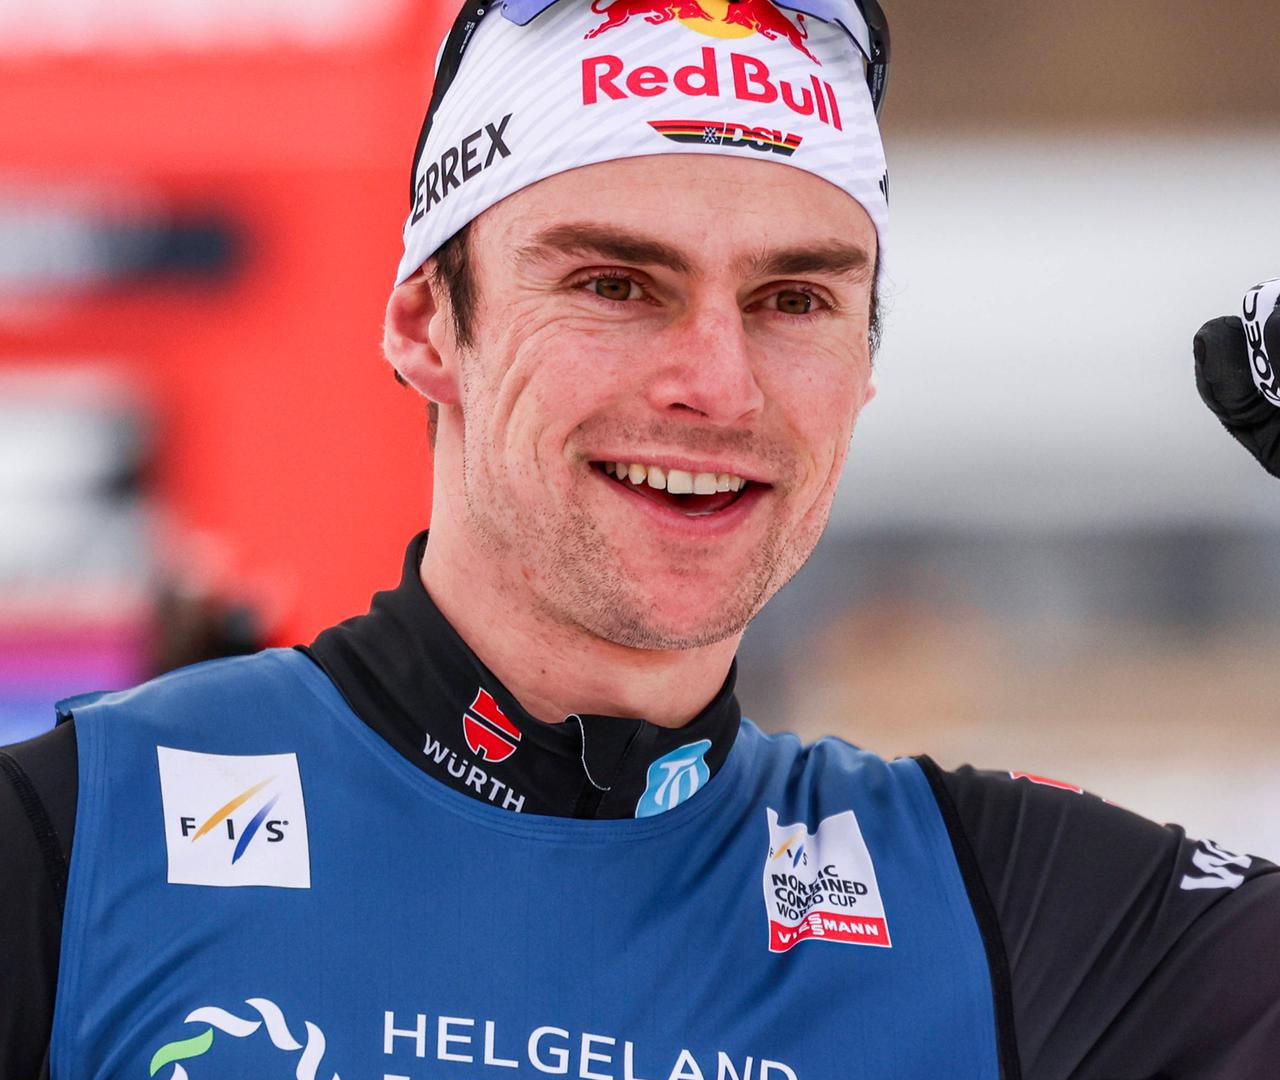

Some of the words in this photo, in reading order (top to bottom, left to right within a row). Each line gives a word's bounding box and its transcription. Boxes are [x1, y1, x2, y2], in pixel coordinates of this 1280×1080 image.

[581, 46, 720, 106] Red
[729, 52, 843, 132] Bull
[722, 121, 804, 157] DSV
[423, 732, 526, 813] WÜRTH
[771, 864, 839, 897] NORIC
[828, 893, 857, 908] CUP
